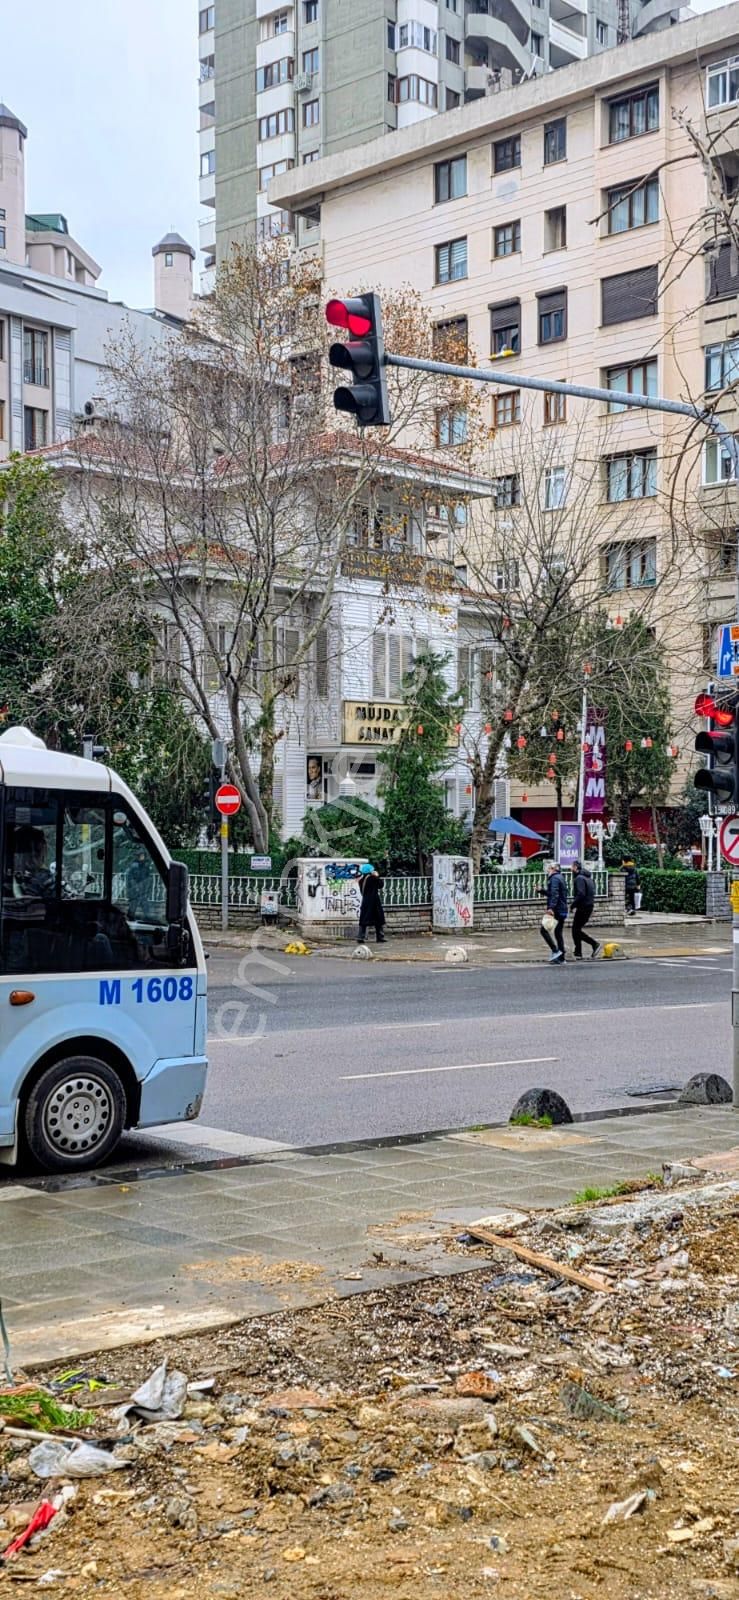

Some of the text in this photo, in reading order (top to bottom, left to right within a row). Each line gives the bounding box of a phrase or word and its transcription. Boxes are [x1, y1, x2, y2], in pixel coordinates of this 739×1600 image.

[356, 703, 402, 721] MÜJDA
[100, 976, 193, 1005] M 1608
